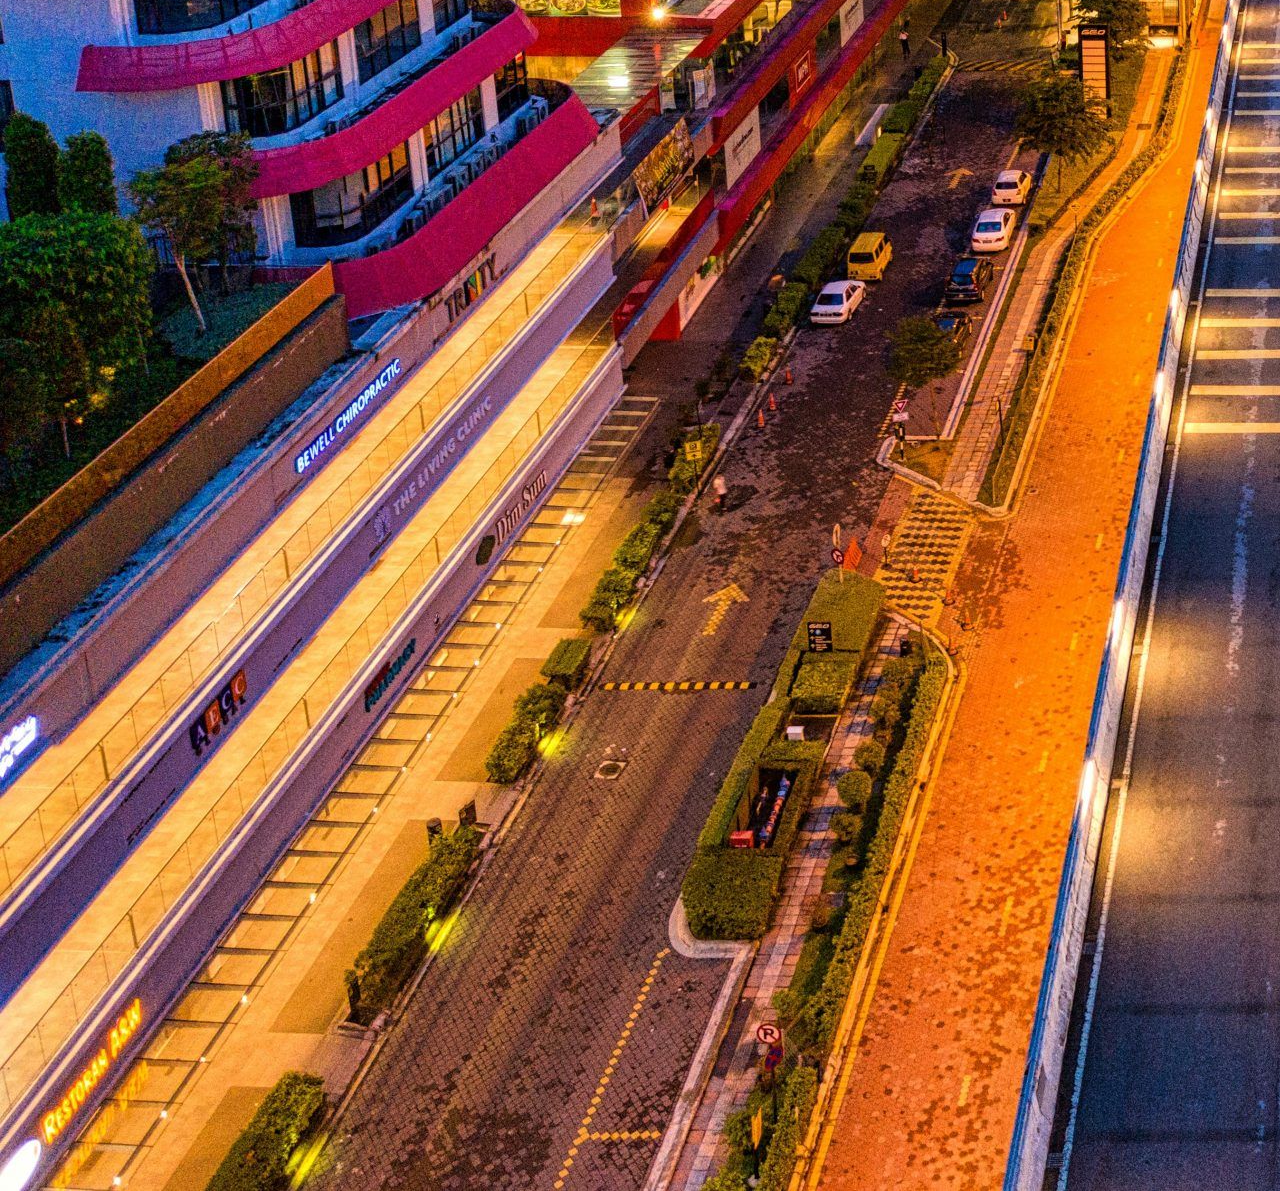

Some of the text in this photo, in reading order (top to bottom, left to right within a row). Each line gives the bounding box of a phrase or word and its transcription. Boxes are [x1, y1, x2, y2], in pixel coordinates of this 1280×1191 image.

[296, 358, 401, 474] BEWELL CHIROPRACTIC
[392, 395, 493, 516] THE LIVING CLINIC
[495, 469, 548, 545] Dim Sum
[42, 1047, 109, 1144] RESTORAN
